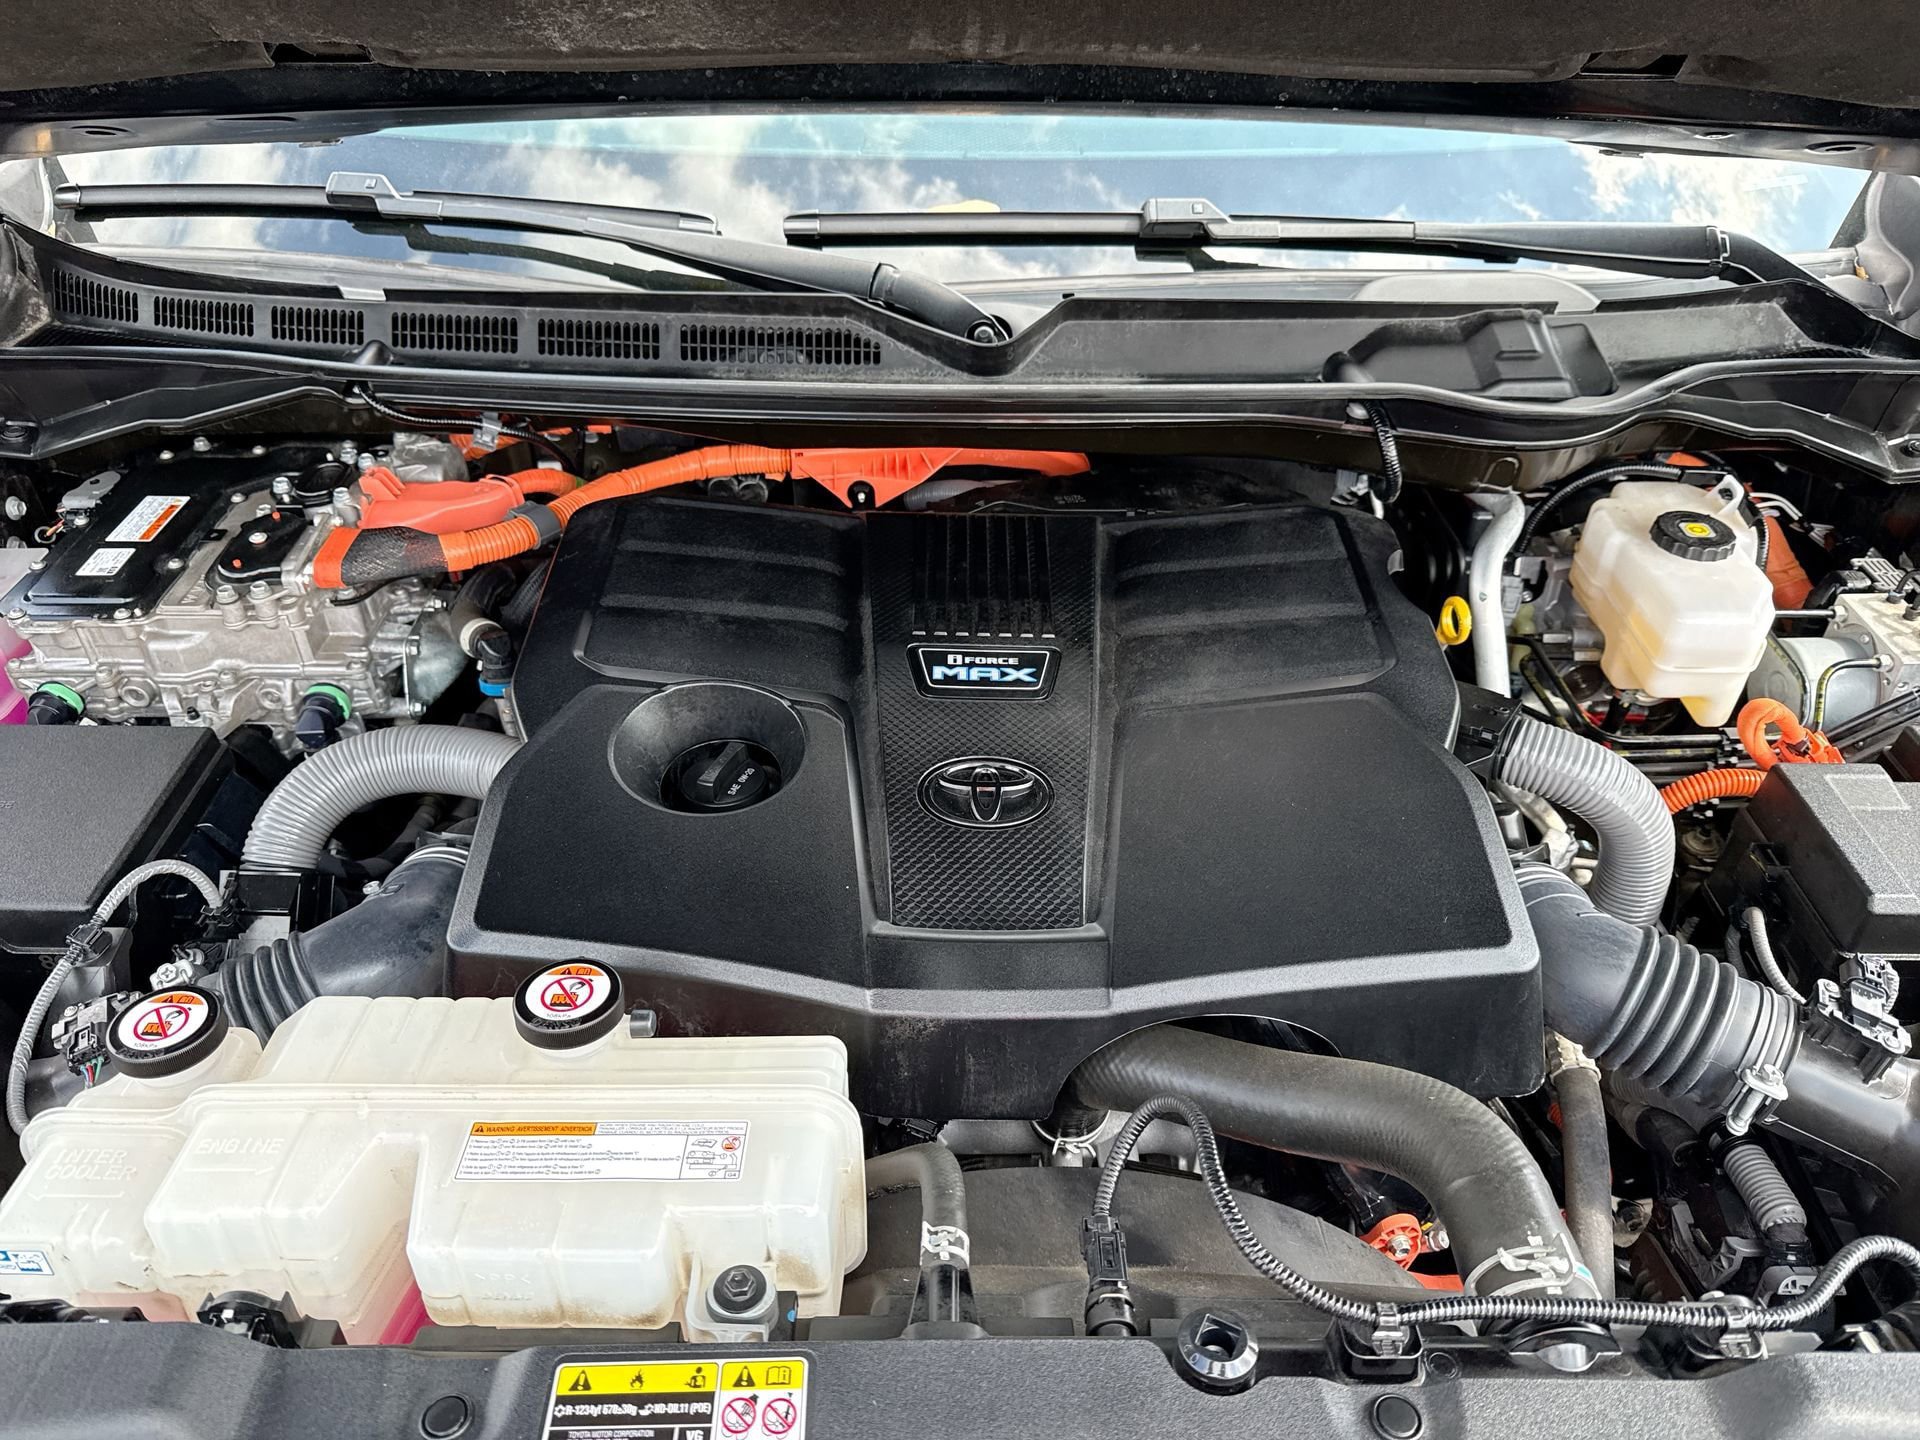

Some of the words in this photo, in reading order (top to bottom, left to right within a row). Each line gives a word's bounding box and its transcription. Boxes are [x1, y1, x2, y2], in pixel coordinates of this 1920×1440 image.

[964, 656, 1020, 666] FORCE
[932, 665, 1038, 683] MAX
[727, 783, 742, 796] SAE
[486, 1125, 515, 1133] WARNING
[198, 1137, 286, 1155] ENGINE
[52, 1149, 128, 1164] INTER
[43, 1163, 138, 1182] COOLER
[689, 1402, 712, 1416] (POE)
[591, 1430, 613, 1438] MOTOR
[613, 1429, 655, 1437] CORPORATION
